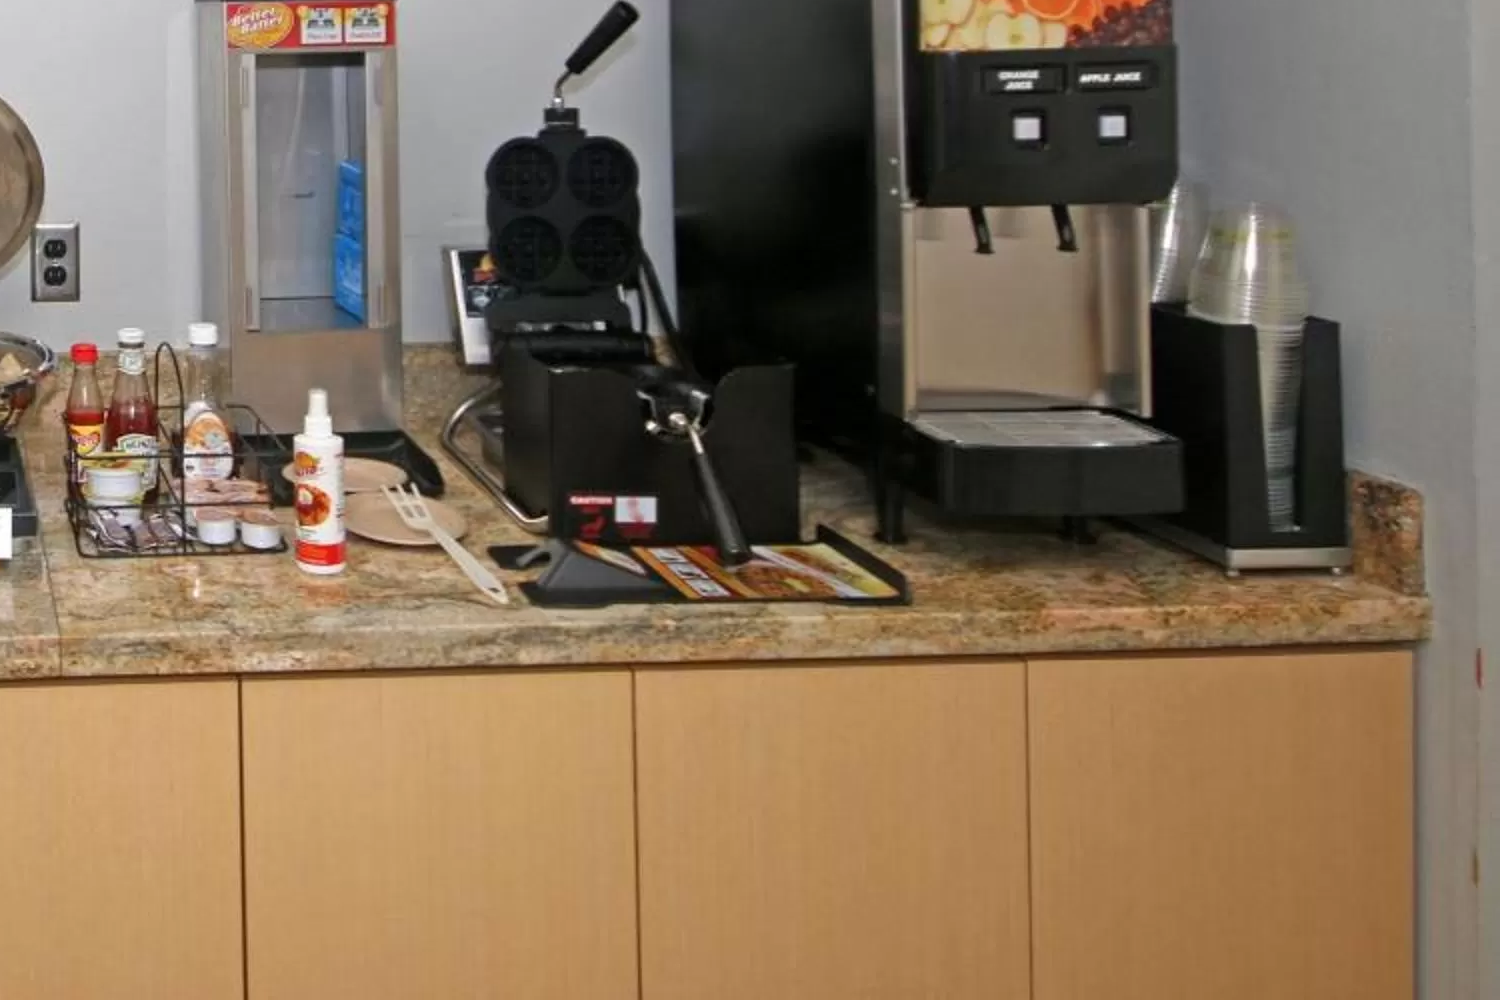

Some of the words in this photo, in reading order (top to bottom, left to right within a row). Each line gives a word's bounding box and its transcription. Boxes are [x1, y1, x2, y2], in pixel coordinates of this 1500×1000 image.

[1079, 73, 1111, 83] APPLE
[1113, 71, 1142, 82] JUICE
[1004, 81, 1034, 91] JUICE
